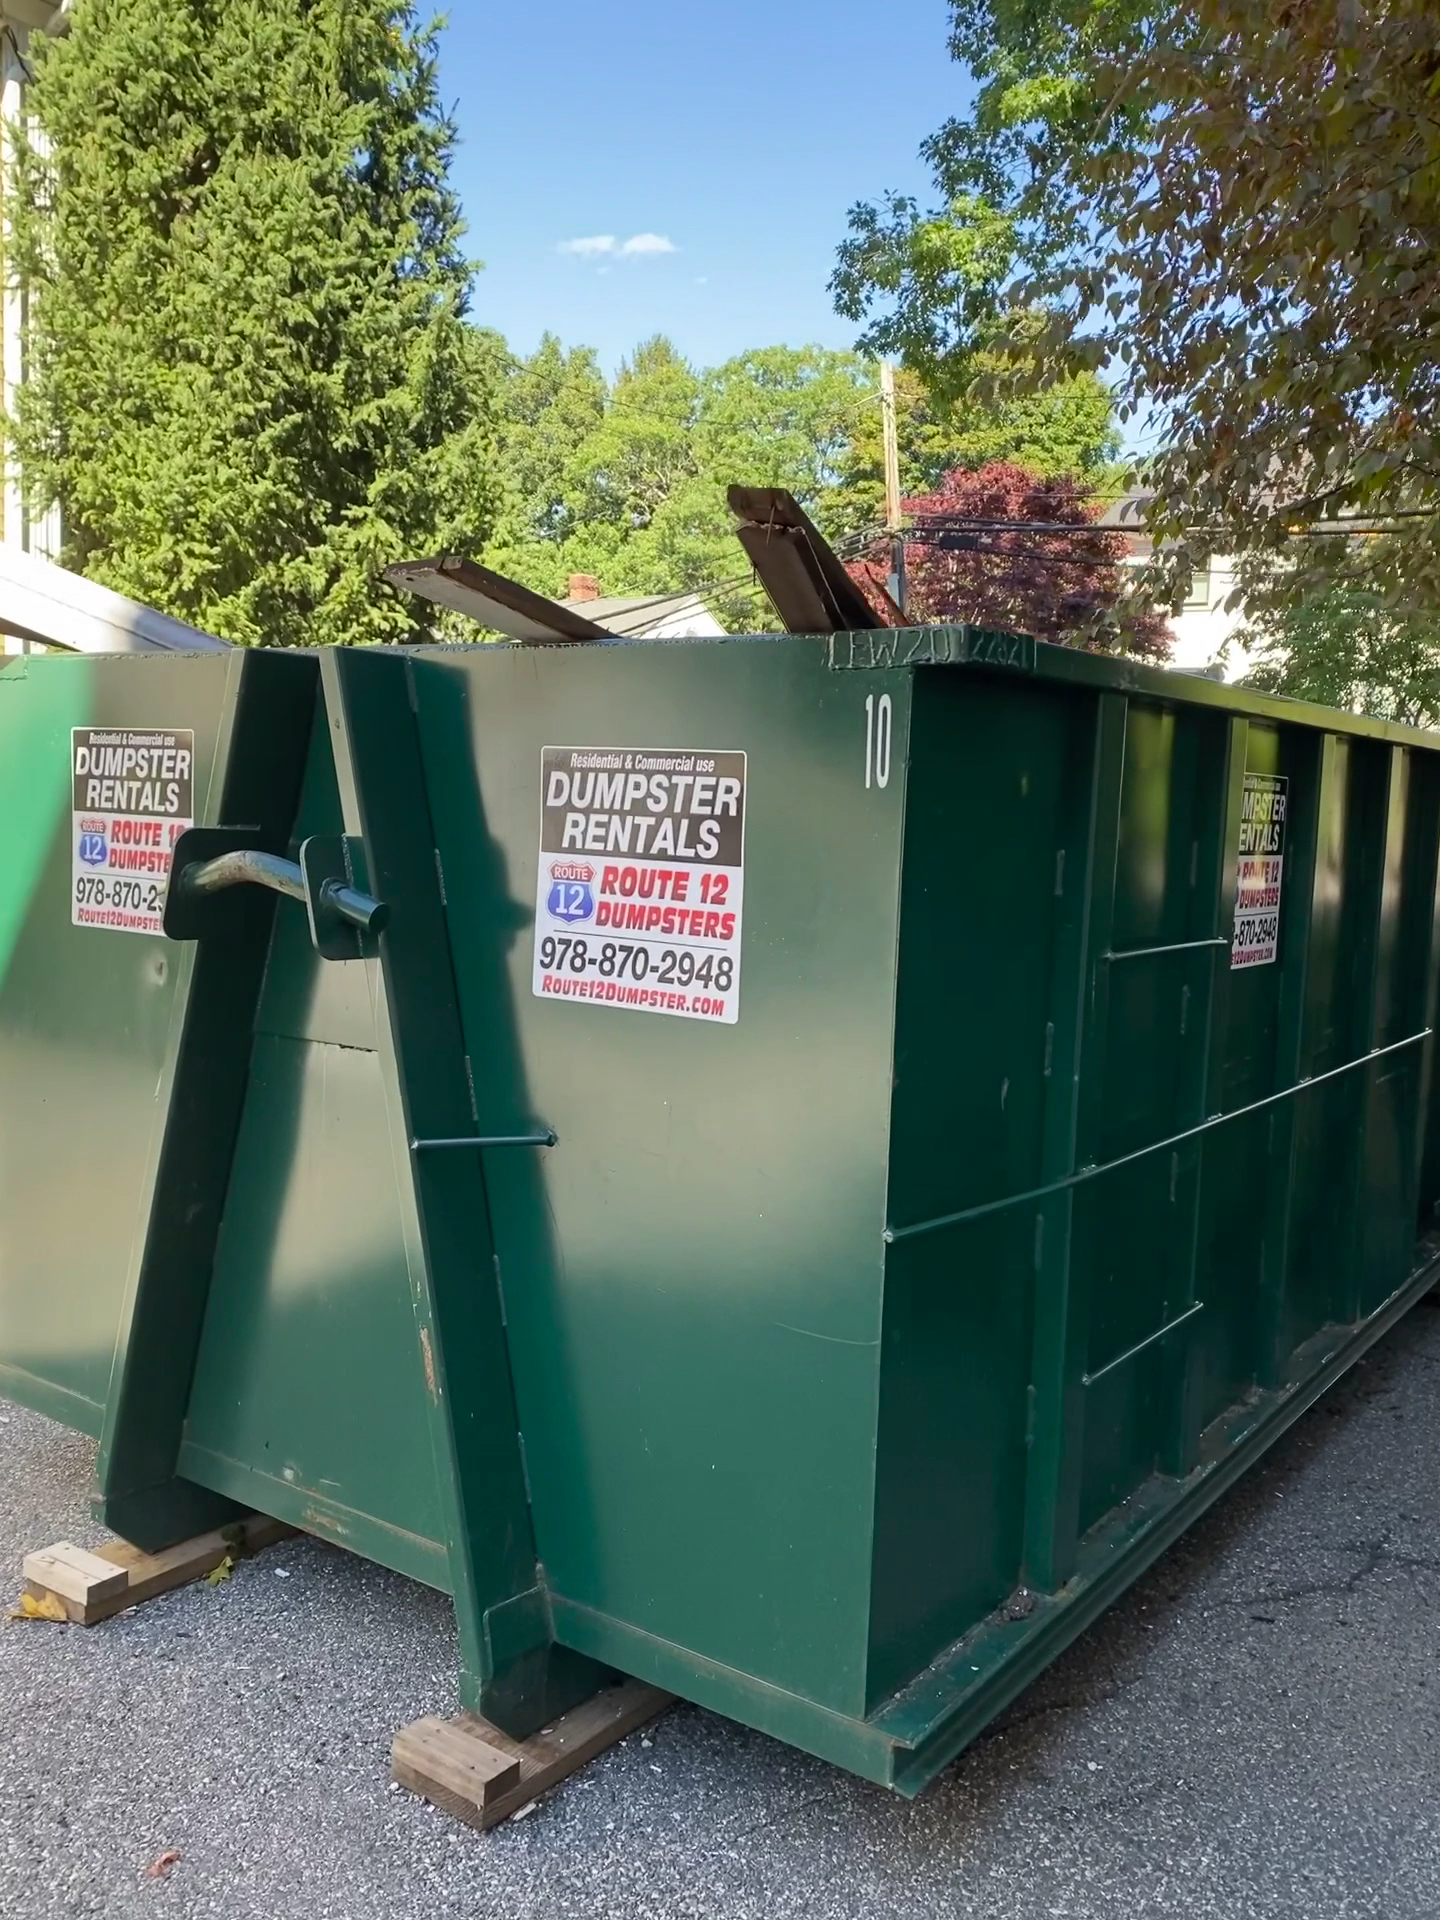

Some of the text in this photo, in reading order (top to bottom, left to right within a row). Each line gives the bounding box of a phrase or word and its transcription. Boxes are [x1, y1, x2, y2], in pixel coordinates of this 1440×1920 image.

[89, 732, 175, 747] Residential & Commercial use
[865, 693, 892, 789] 10
[75, 746, 191, 780] DUMPSTER
[570, 752, 715, 772] Residential & Commercial use
[86, 778, 180, 813] RENTALS
[546, 770, 742, 816] DUMPSTER
[82, 822, 105, 833] ROUTE
[110, 820, 163, 847] ROUTE
[561, 812, 722, 860] RENTALS
[84, 835, 102, 860] 12
[554, 866, 589, 881] ROUTE
[600, 865, 730, 906] ROUTE 12
[1242, 861, 1280, 883] ROUTE 12
[75, 876, 164, 912] 978-870-2
[555, 884, 585, 915] 12
[1238, 887, 1280, 909] DUMPSTERS
[595, 901, 736, 940] DUMPSTERS
[1232, 916, 1277, 946] -870-2948
[539, 936, 734, 993] 978-870-2948
